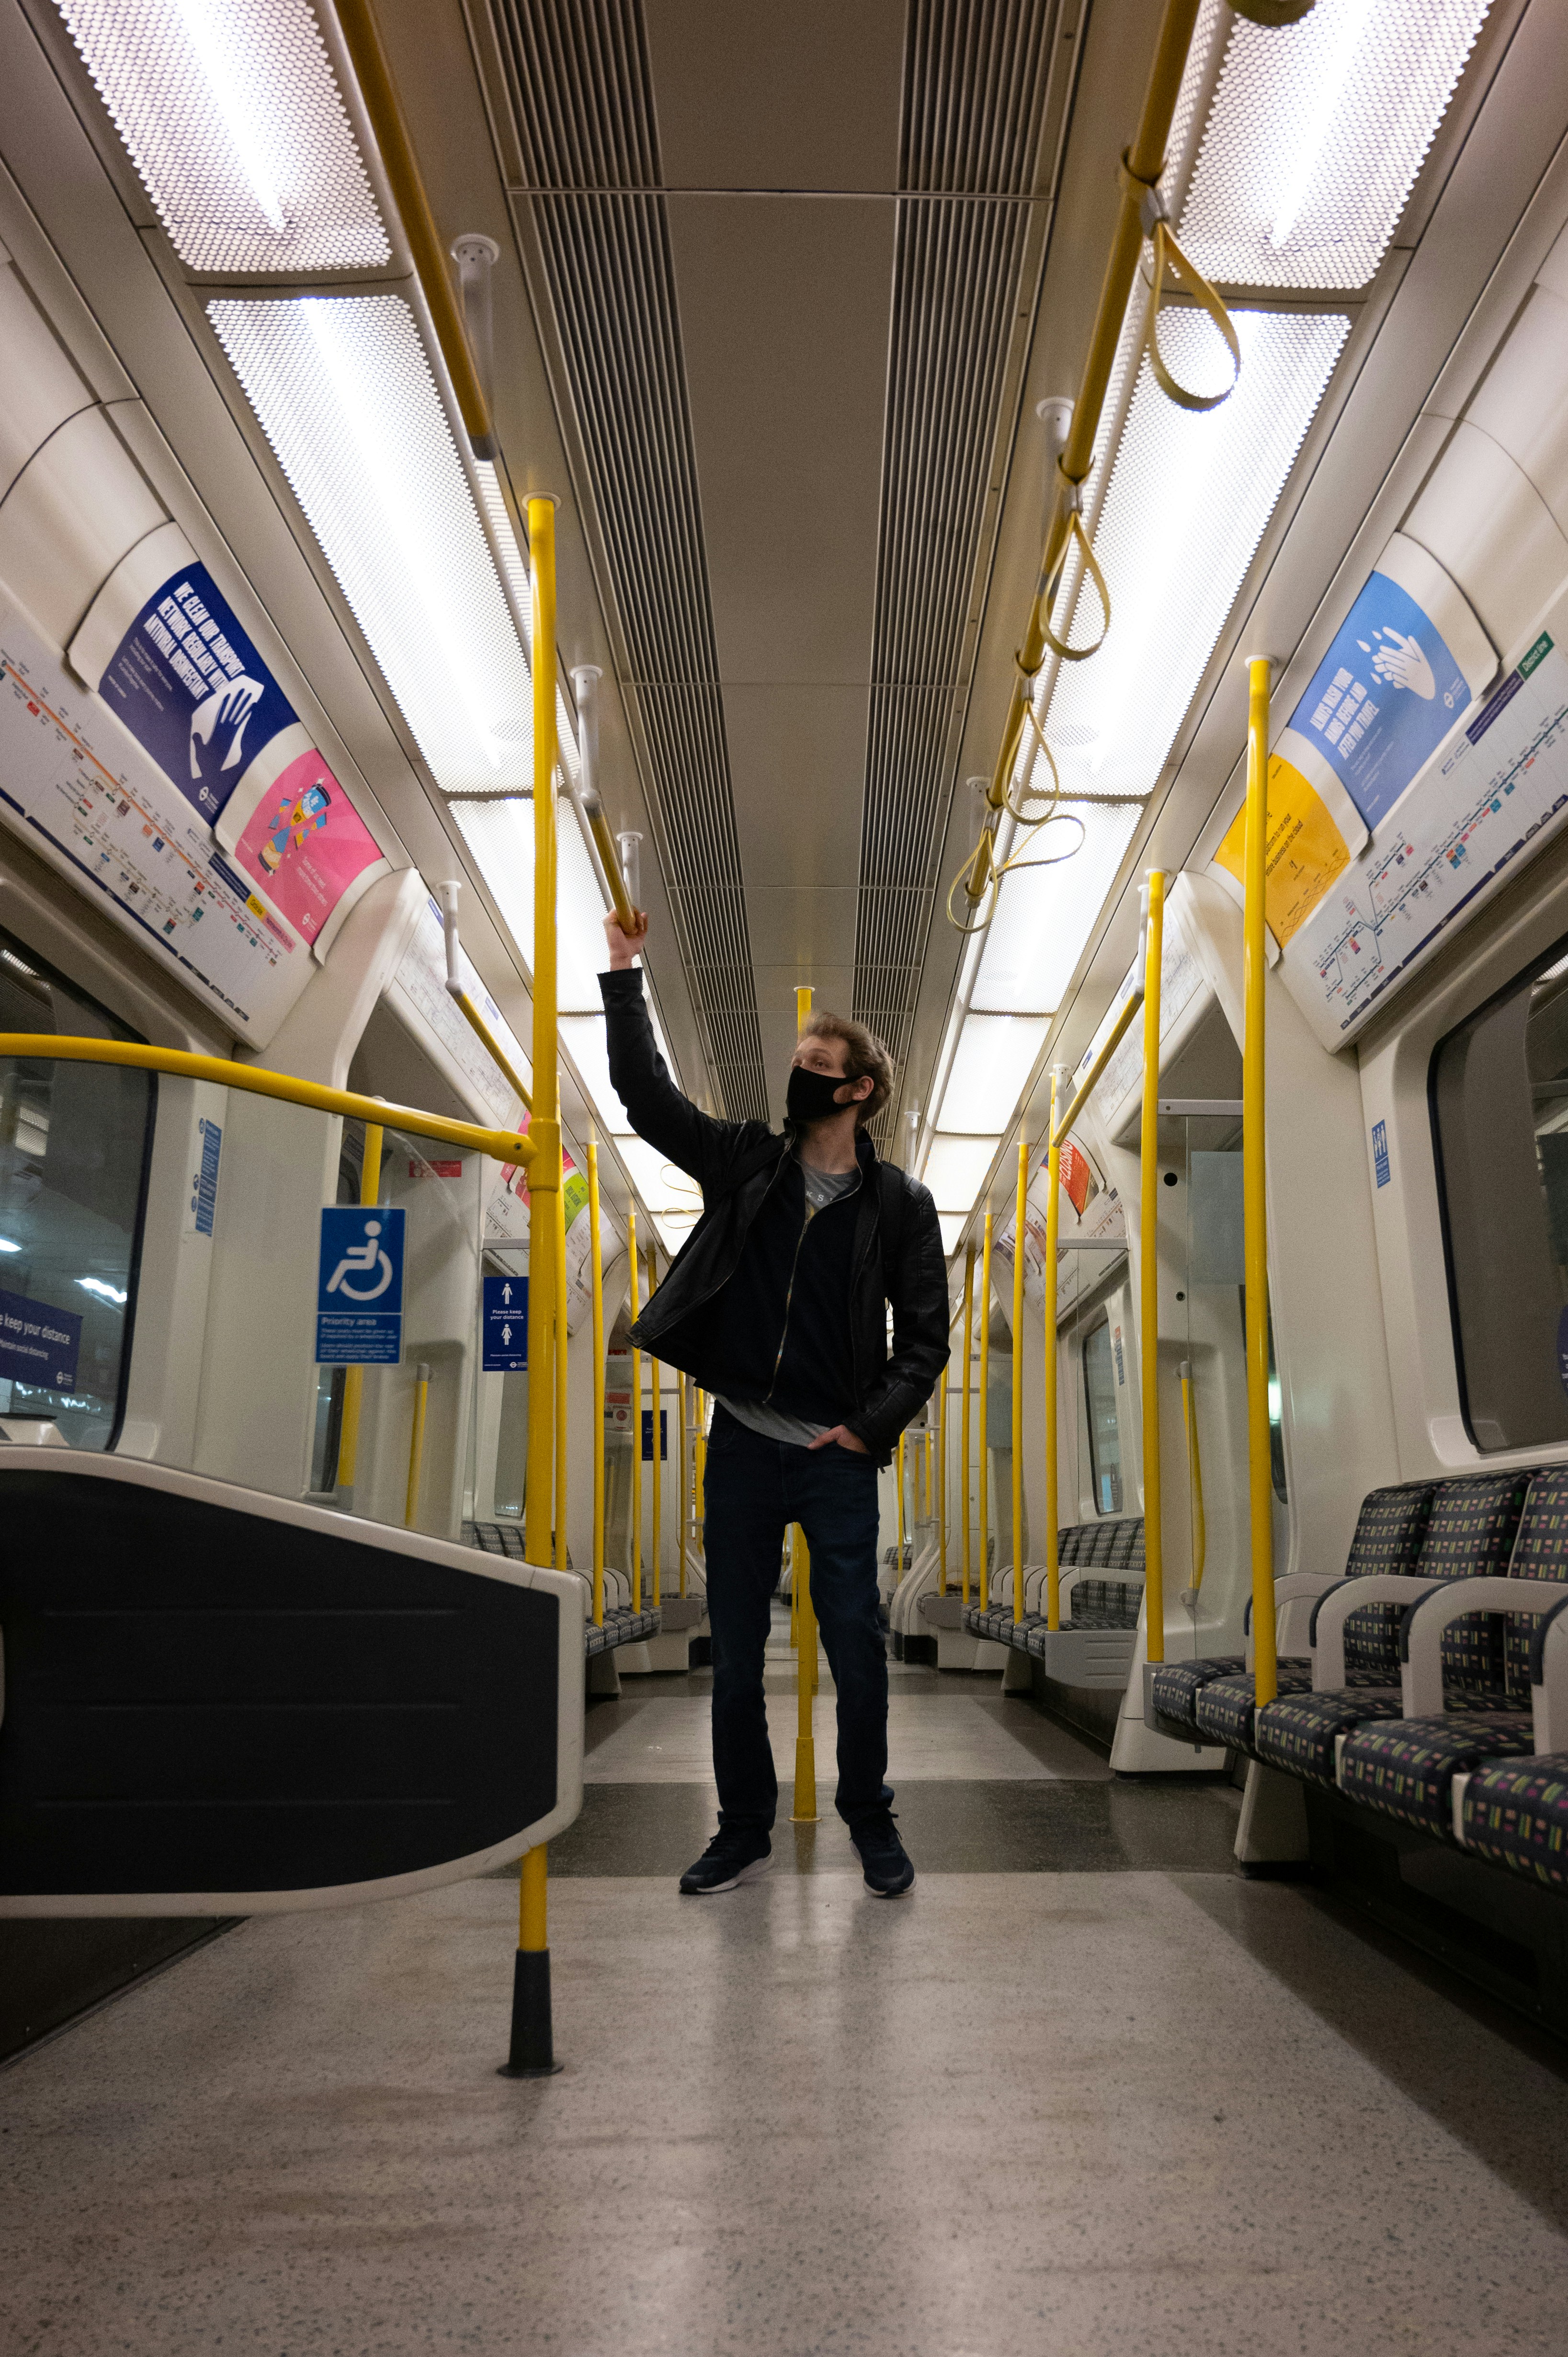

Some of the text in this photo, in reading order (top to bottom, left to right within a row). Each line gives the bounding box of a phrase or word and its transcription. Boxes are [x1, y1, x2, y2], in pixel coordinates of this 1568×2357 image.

[144, 613, 209, 700] ANTIVIRAL DISINFECTANT
[157, 596, 192, 641] NETWORK
[182, 631, 218, 676] REGULARLY
[173, 582, 245, 678] WE CLEAN OUR TRANSPORT
[1310, 667, 1354, 732] ALWAYS WASH YOUR
[1324, 682, 1367, 745] HANDS BEFORE AND
[1338, 732, 1357, 760] AFTER
[1348, 721, 1364, 742] YOU
[1356, 699, 1380, 730] TRAVEL
[1272, 846, 1286, 865] business
[1284, 840, 1290, 848] on
[1287, 833, 1295, 843] the
[1292, 818, 1303, 835] cloud
[4, 1313, 23, 1333] keep
[23, 1322, 41, 1335] your
[42, 1325, 70, 1344] distance
[321, 1317, 355, 1327] Priority
